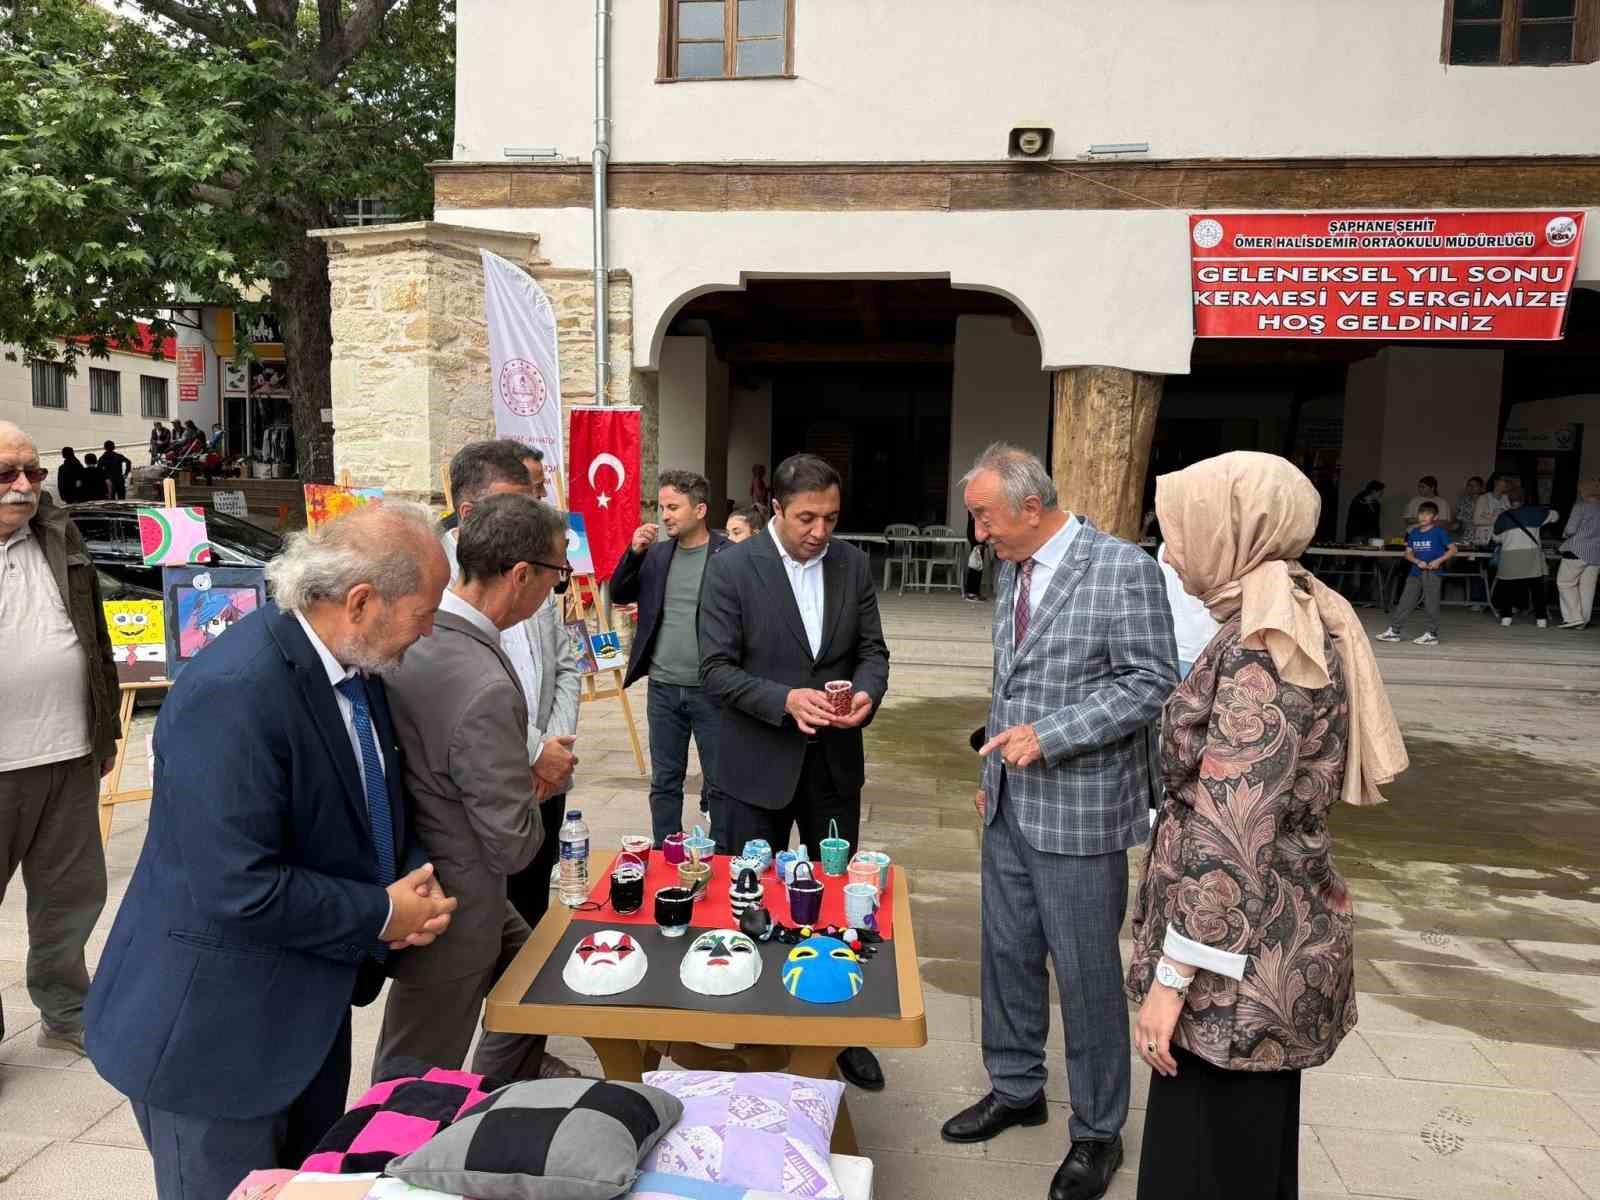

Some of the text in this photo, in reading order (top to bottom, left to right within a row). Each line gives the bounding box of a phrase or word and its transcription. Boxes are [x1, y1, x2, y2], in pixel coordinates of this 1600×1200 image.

[1329, 218, 1435, 235] ŞAPHANE ŞEHİT
[1235, 234, 1273, 248] ÖMER
[1276, 234, 1358, 248] HALİSDEMİR
[1362, 236, 1442, 248] ORTAOKULU
[1445, 232, 1535, 247] MÜDÜRLÜĞÜ
[1198, 266, 1564, 283] GELENEKSEL YIL SONU
[1193, 287, 1568, 307] KERMESİ VE SERGİMİZE
[1257, 311, 1494, 334] HOŞ GELDİNİZ
